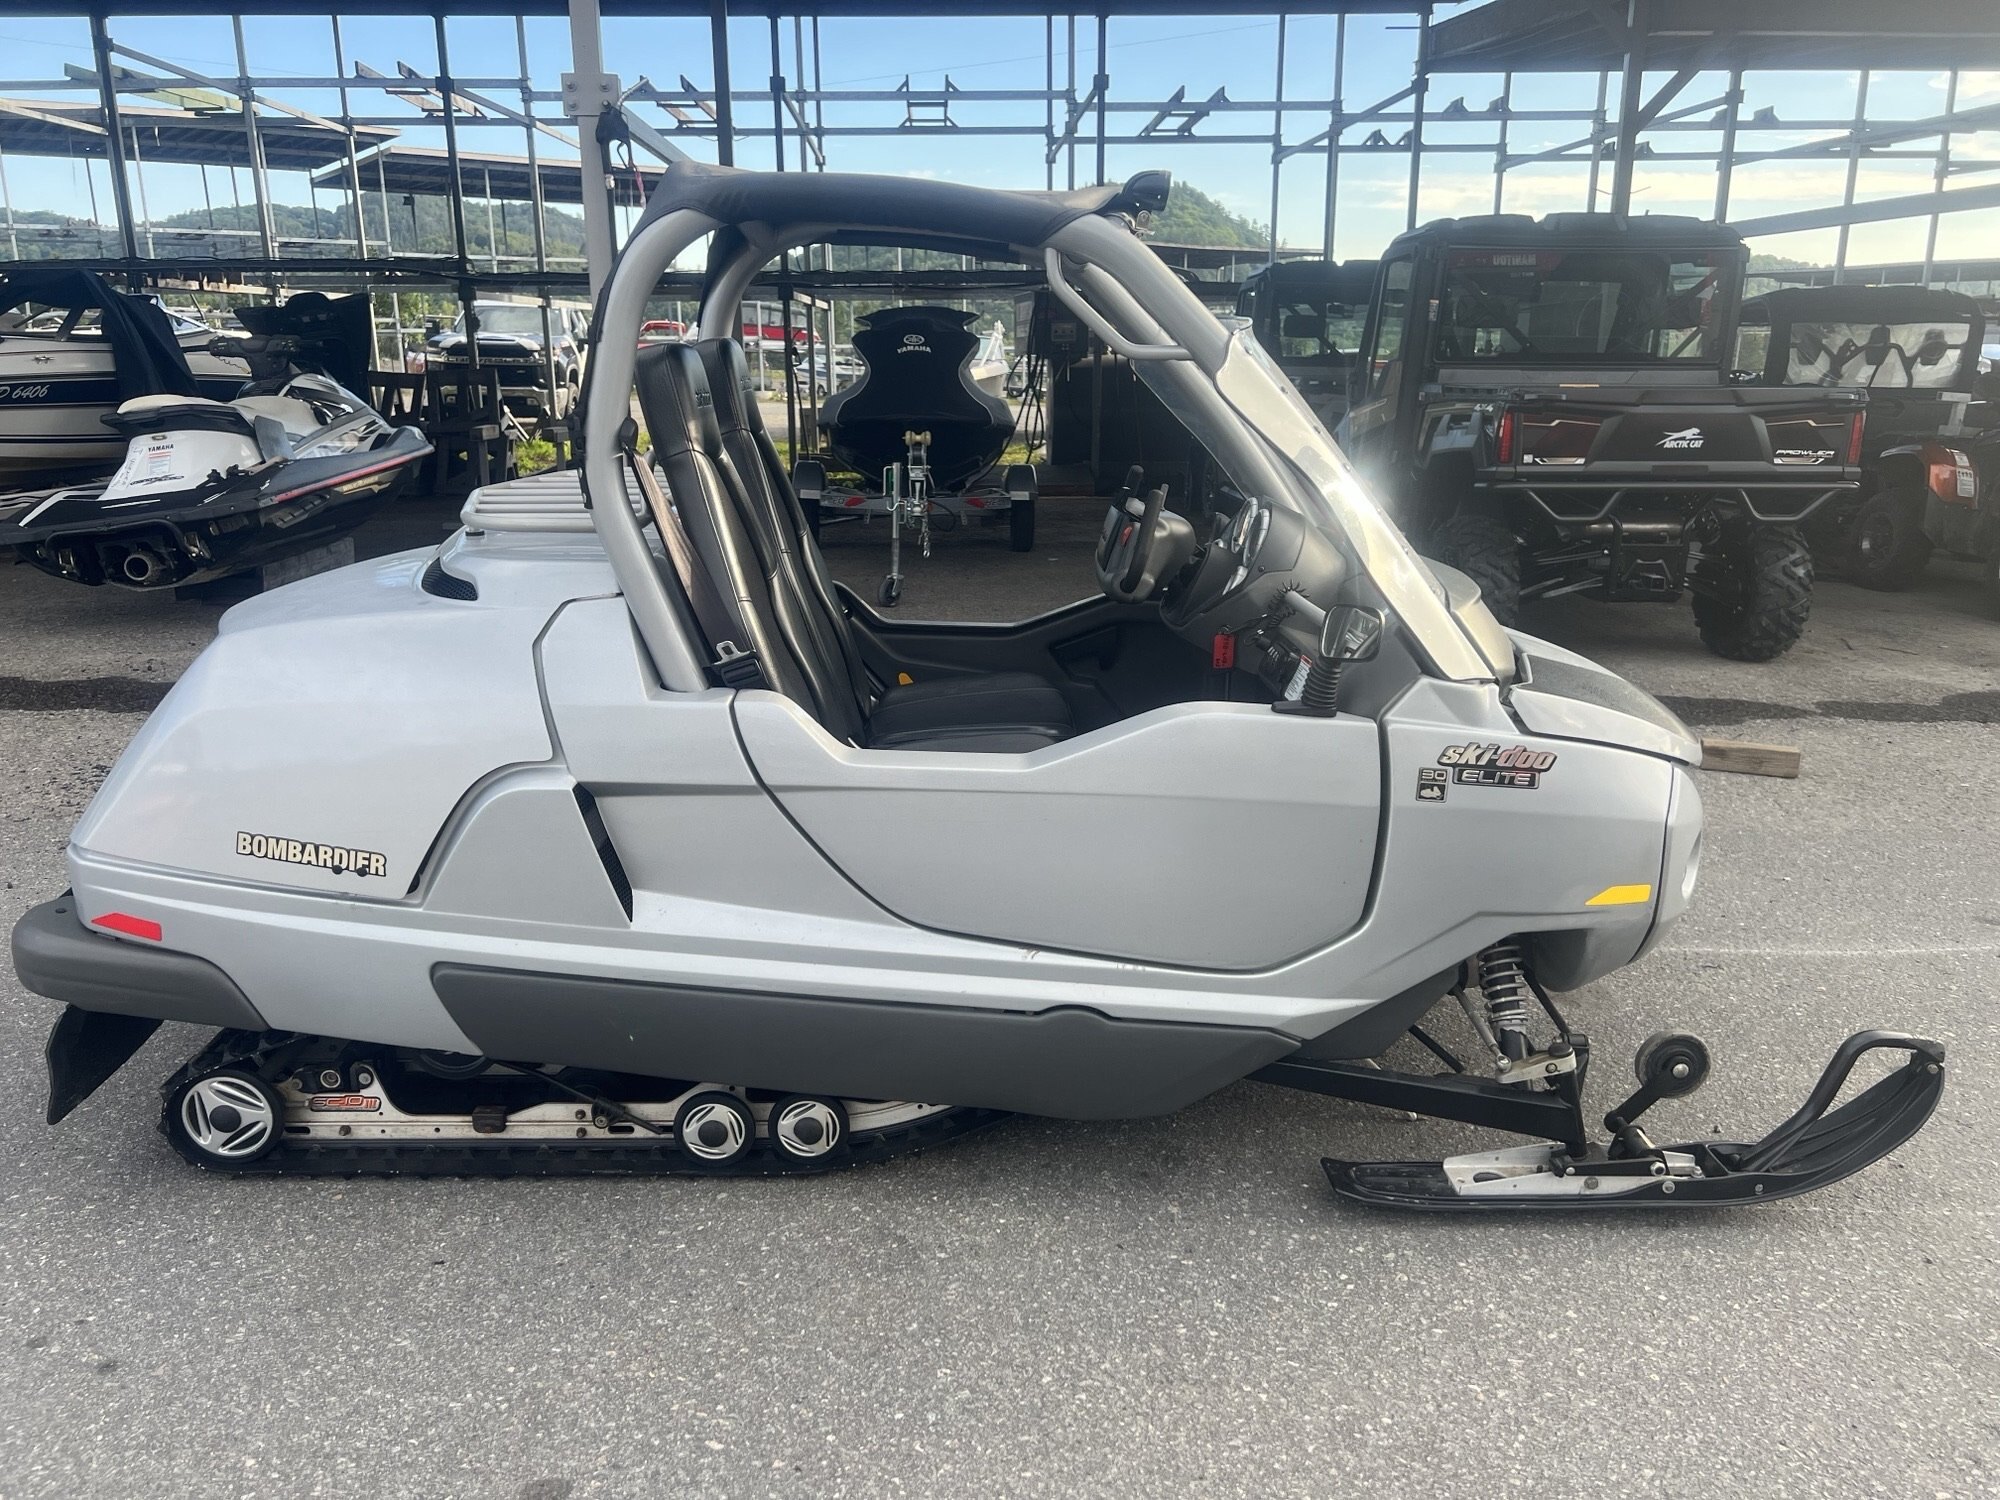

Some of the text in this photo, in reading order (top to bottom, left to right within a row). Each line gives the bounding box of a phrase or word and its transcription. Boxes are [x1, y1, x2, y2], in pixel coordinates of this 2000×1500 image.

[897, 345, 931, 354] YAMAHA
[12, 384, 50, 399] 6406
[148, 443, 174, 452] YAMAHA
[1663, 440, 1704, 448] ARCTIC CAT
[1422, 769, 1447, 780] 30
[1461, 769, 1532, 786] ELITE
[236, 831, 387, 877] BOMBARDIER
